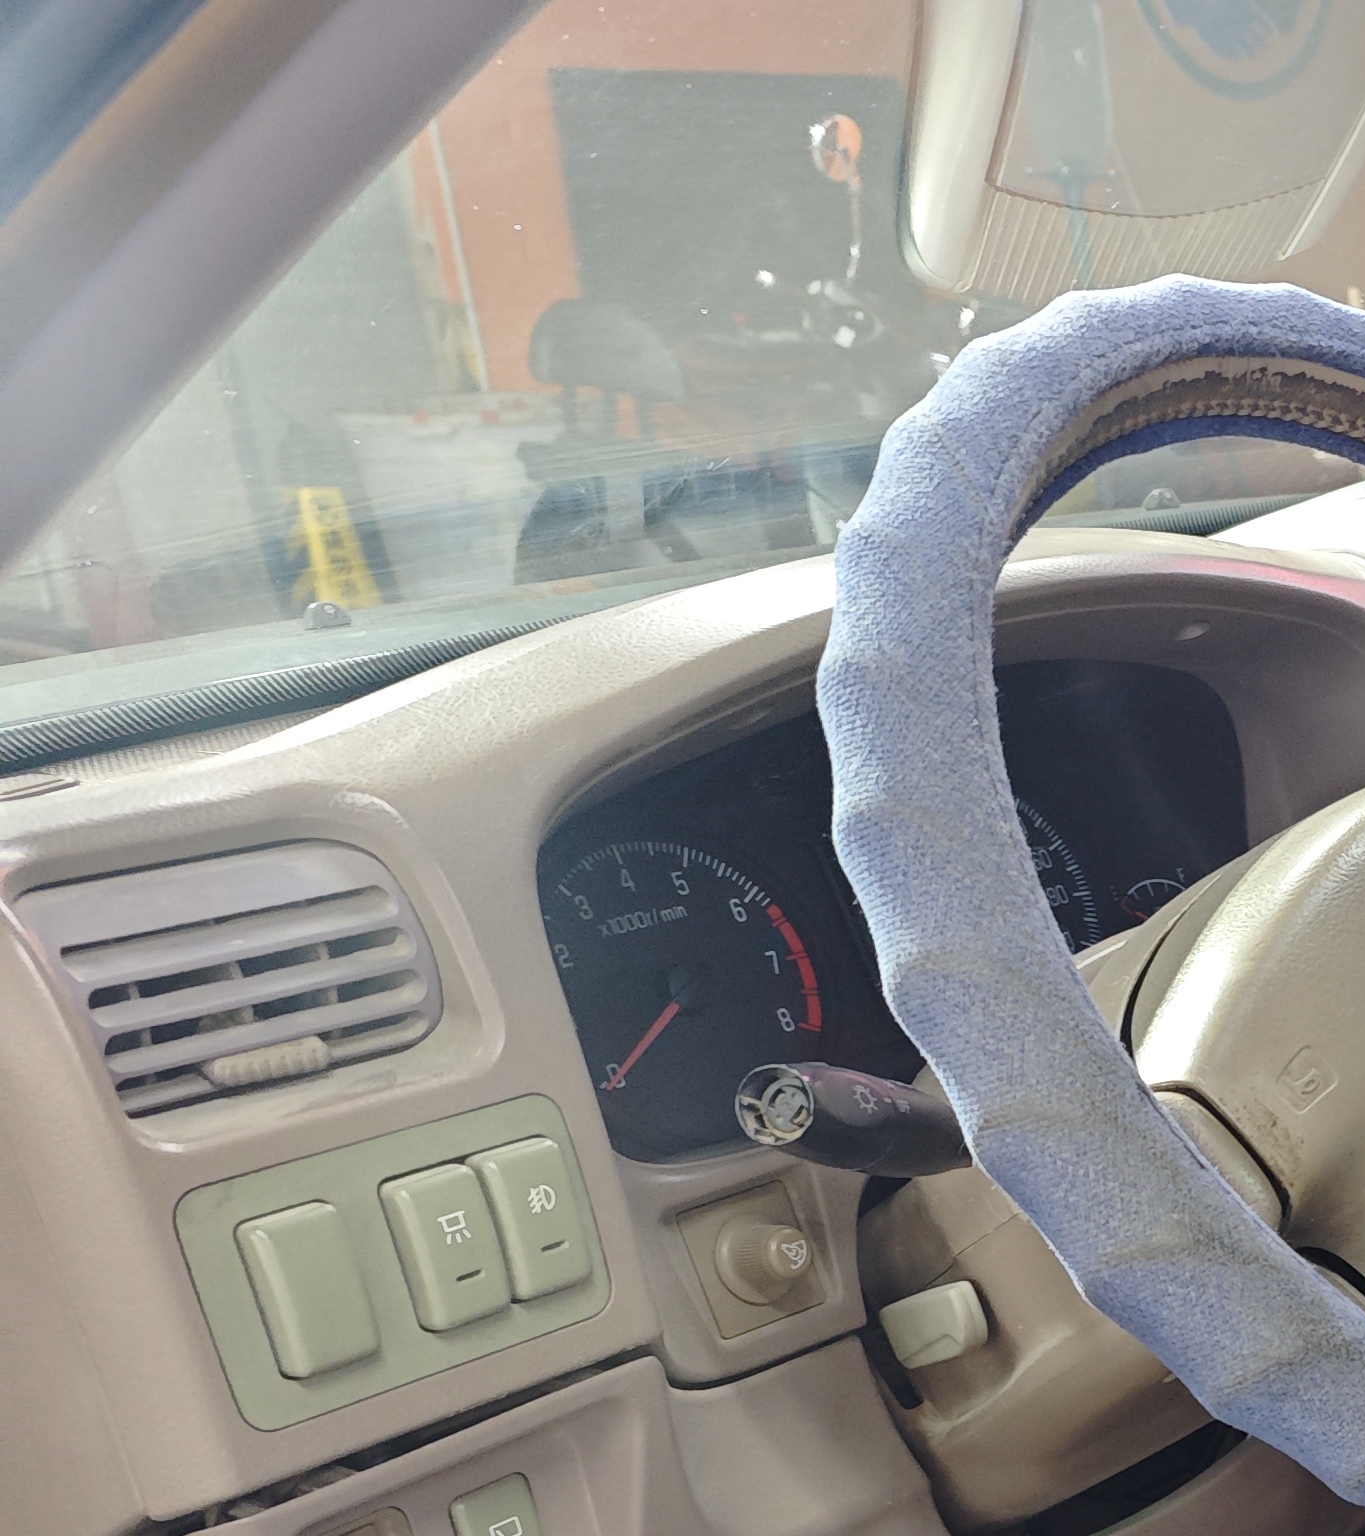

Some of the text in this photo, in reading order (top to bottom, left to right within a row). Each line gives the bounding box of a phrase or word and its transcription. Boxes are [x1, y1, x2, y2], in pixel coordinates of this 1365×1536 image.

[621, 868, 636, 892] 4
[670, 870, 690, 896] 5
[574, 894, 594, 920] 3
[728, 898, 747, 923] 6
[553, 943, 575, 969] 2
[764, 950, 780, 975] 7
[776, 1007, 796, 1033] 8
